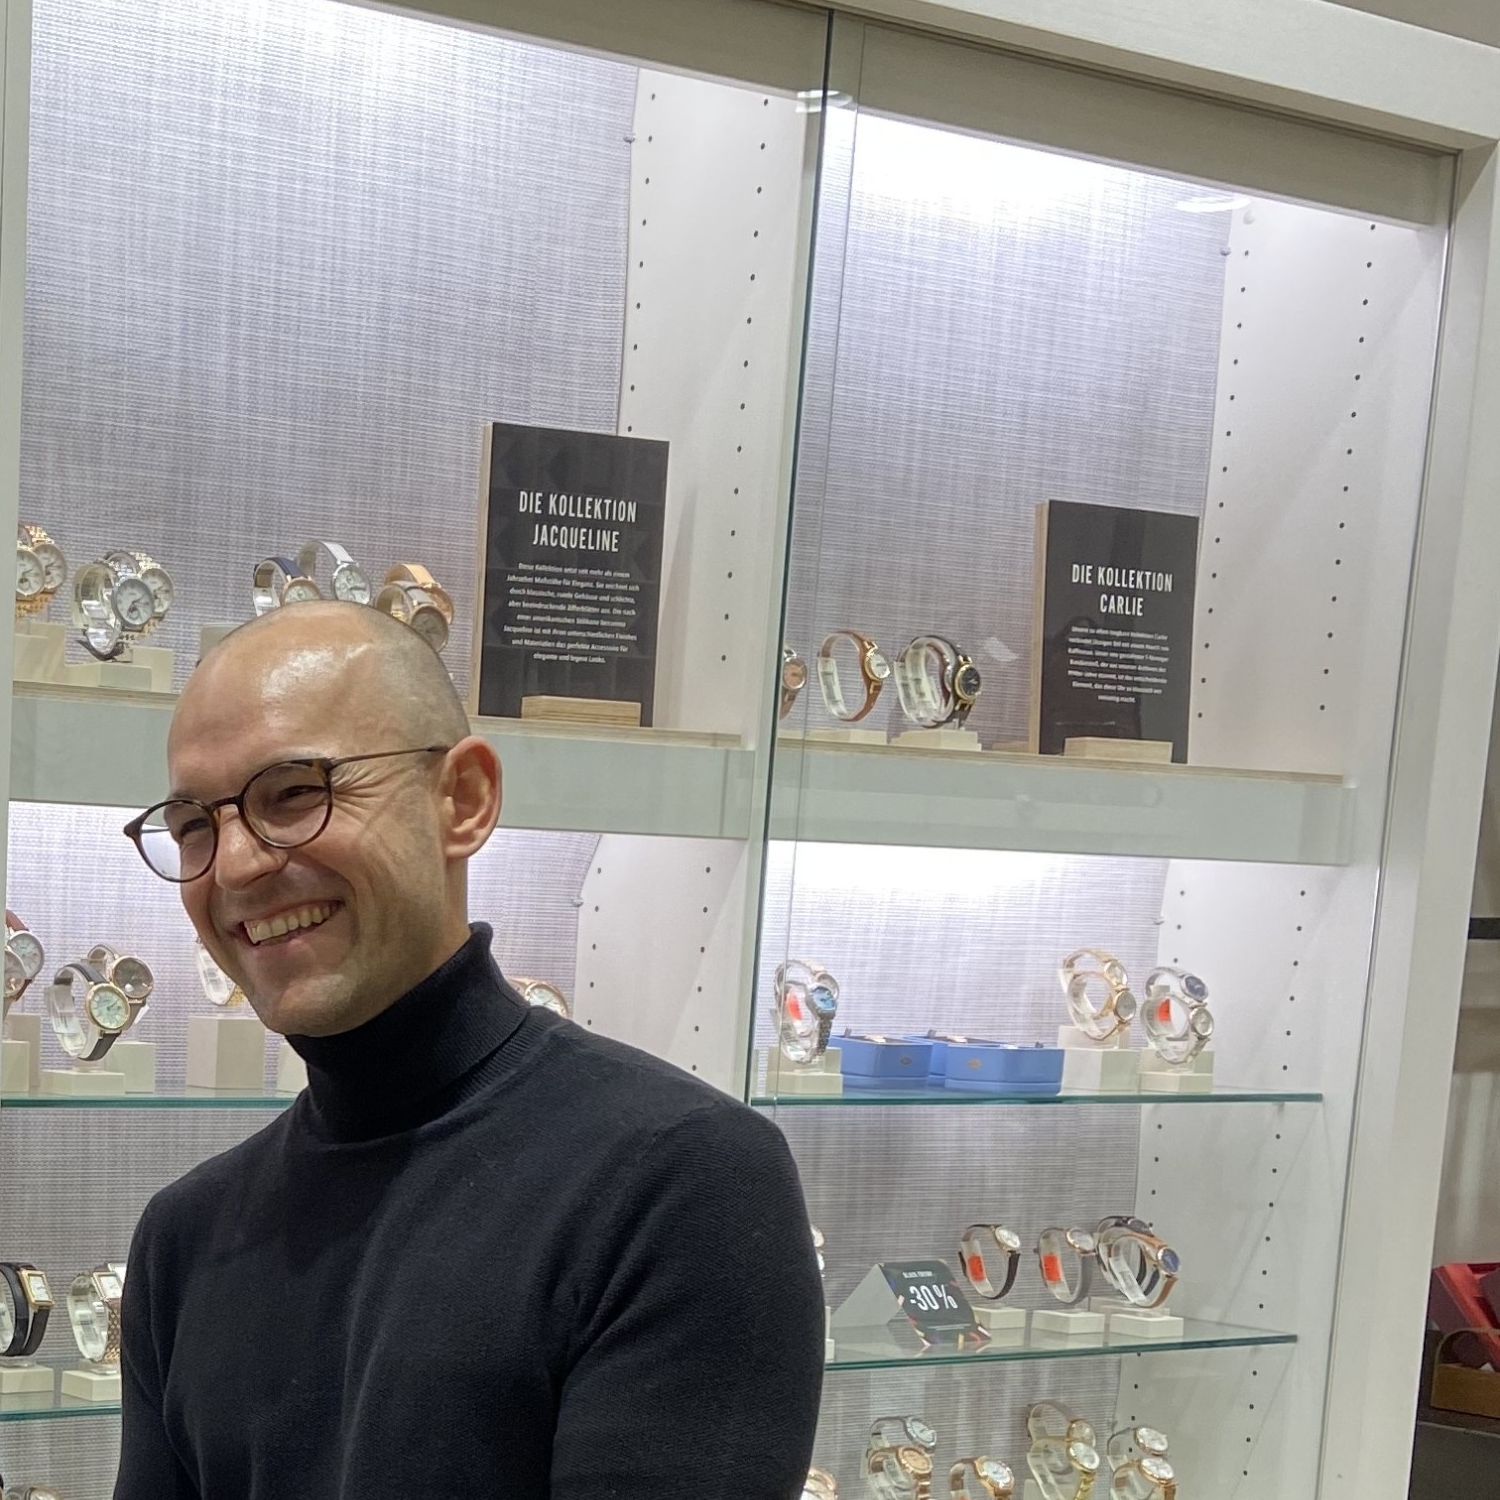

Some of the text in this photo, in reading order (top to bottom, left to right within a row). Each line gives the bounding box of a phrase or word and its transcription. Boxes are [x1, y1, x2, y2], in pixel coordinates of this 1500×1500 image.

[518, 490, 637, 523] DIE KOLLEKTION
[532, 523, 620, 552] JACQUELINE
[1071, 563, 1173, 593] DIE KOLLEKTION
[1100, 594, 1144, 617] CARLIE
